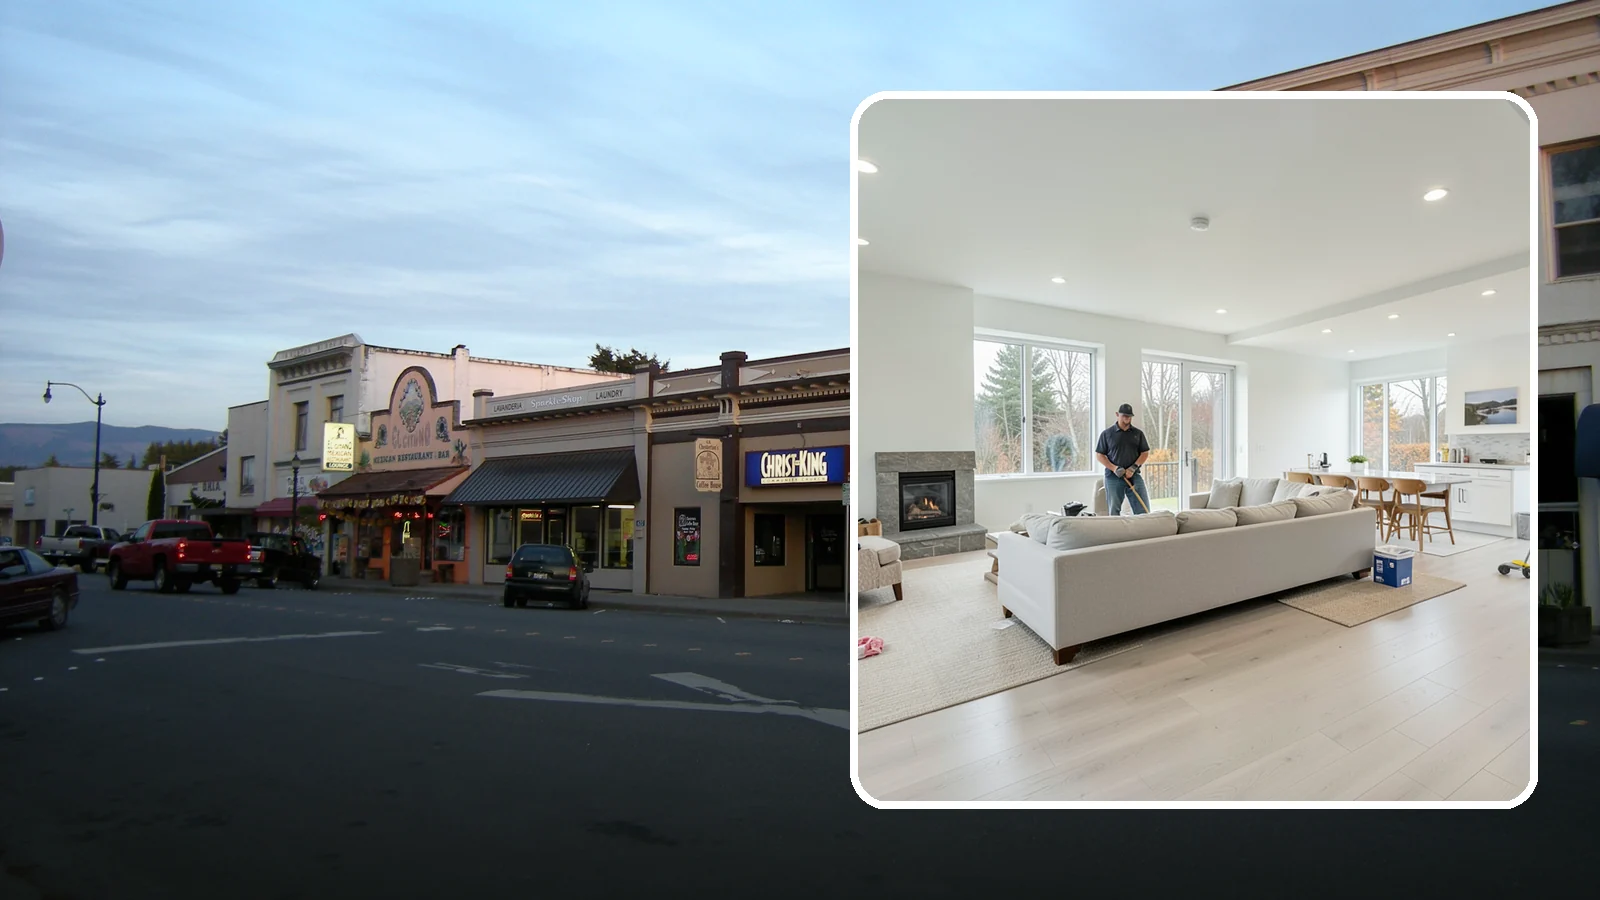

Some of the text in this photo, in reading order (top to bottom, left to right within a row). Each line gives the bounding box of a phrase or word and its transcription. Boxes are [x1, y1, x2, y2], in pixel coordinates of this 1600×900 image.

[563, 394, 582, 404] Shop
[596, 389, 623, 399] LAUNDRY
[494, 402, 522, 412] LAVANDERIA
[374, 450, 450, 463] MEXICAN RESTAURANT BAR
[761, 450, 827, 477] CHRIST KING
